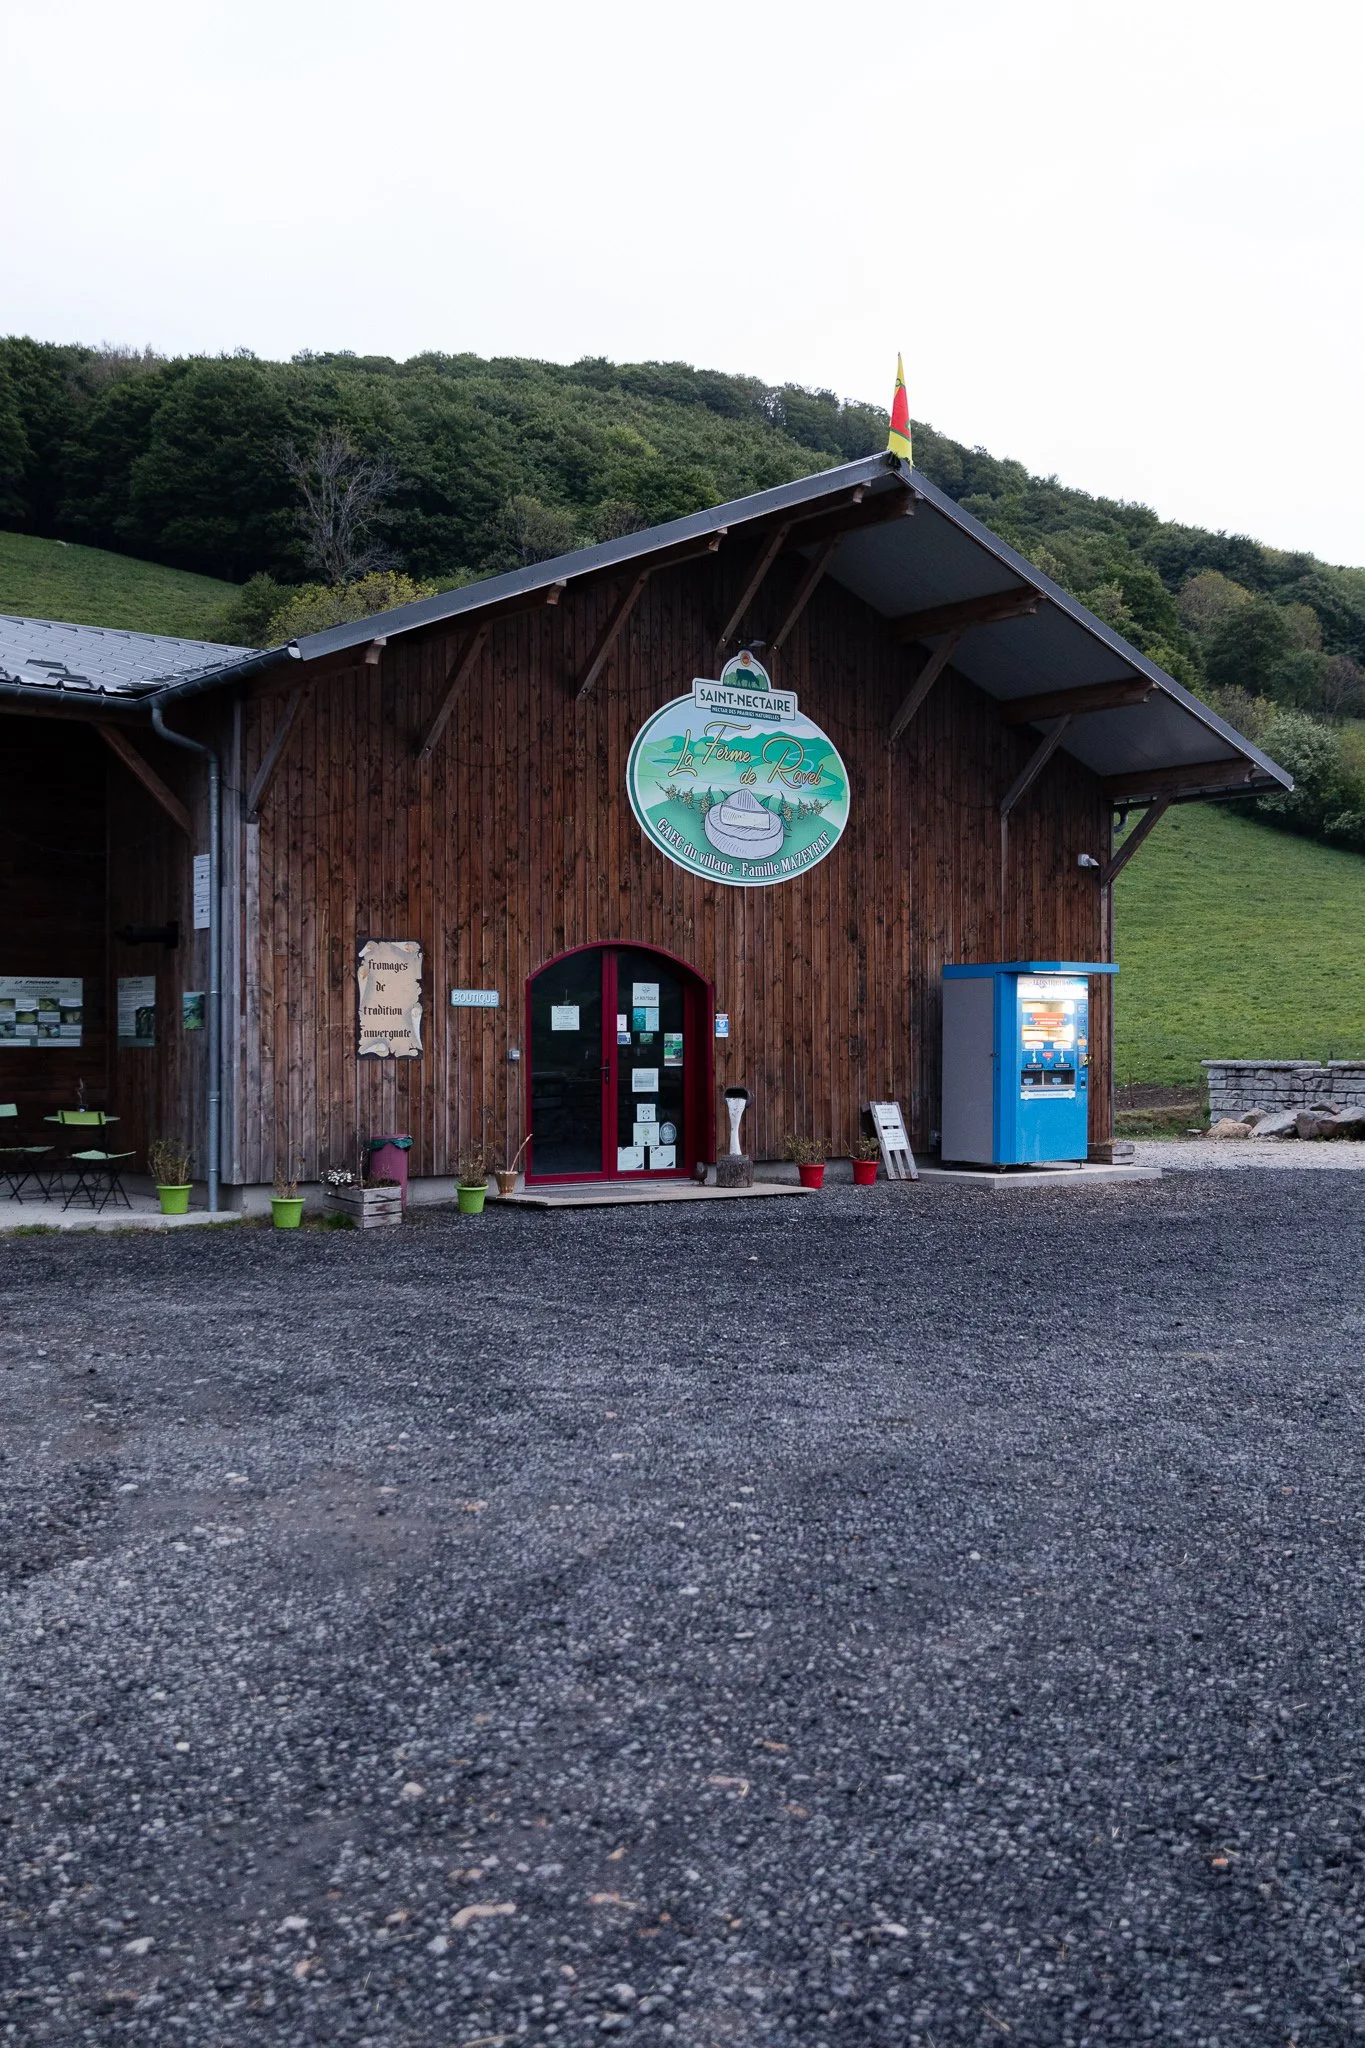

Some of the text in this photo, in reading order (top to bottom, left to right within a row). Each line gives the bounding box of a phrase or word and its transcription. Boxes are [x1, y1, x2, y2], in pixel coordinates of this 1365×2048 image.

[700, 688, 791, 713] SAINT-NECTAIRE
[668, 721, 752, 777] La Ferme
[740, 736, 824, 789] de Ravel
[657, 817, 685, 850] GAEC
[683, 843, 697, 860] du
[699, 851, 734, 875] village
[741, 863, 780, 877] Famille
[780, 831, 831, 873] MAZEYRAT
[368, 959, 408, 973] fromages
[375, 981, 386, 992] de
[453, 992, 498, 1004] BOUTIQUE
[363, 1004, 403, 1016] tradition
